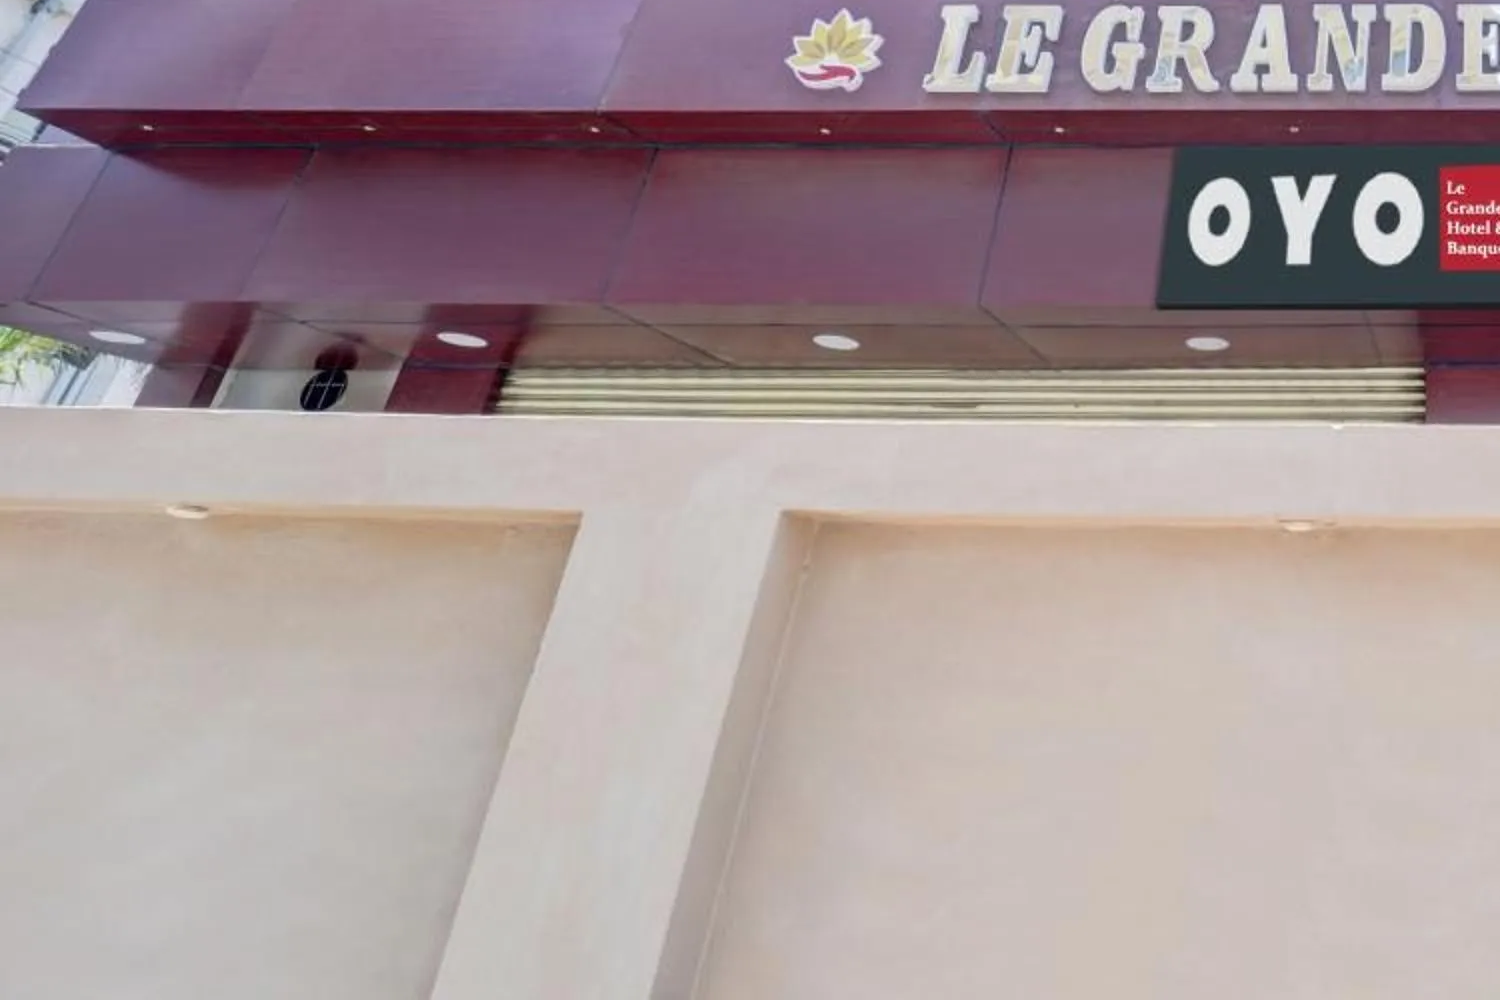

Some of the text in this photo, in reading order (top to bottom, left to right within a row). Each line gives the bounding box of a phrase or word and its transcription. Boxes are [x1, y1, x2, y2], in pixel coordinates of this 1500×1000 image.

[922, 3, 1063, 93] LE
[1446, 180, 1465, 195] Le
[1187, 172, 1425, 267] OYO
[1446, 220, 1491, 235] Hotel
